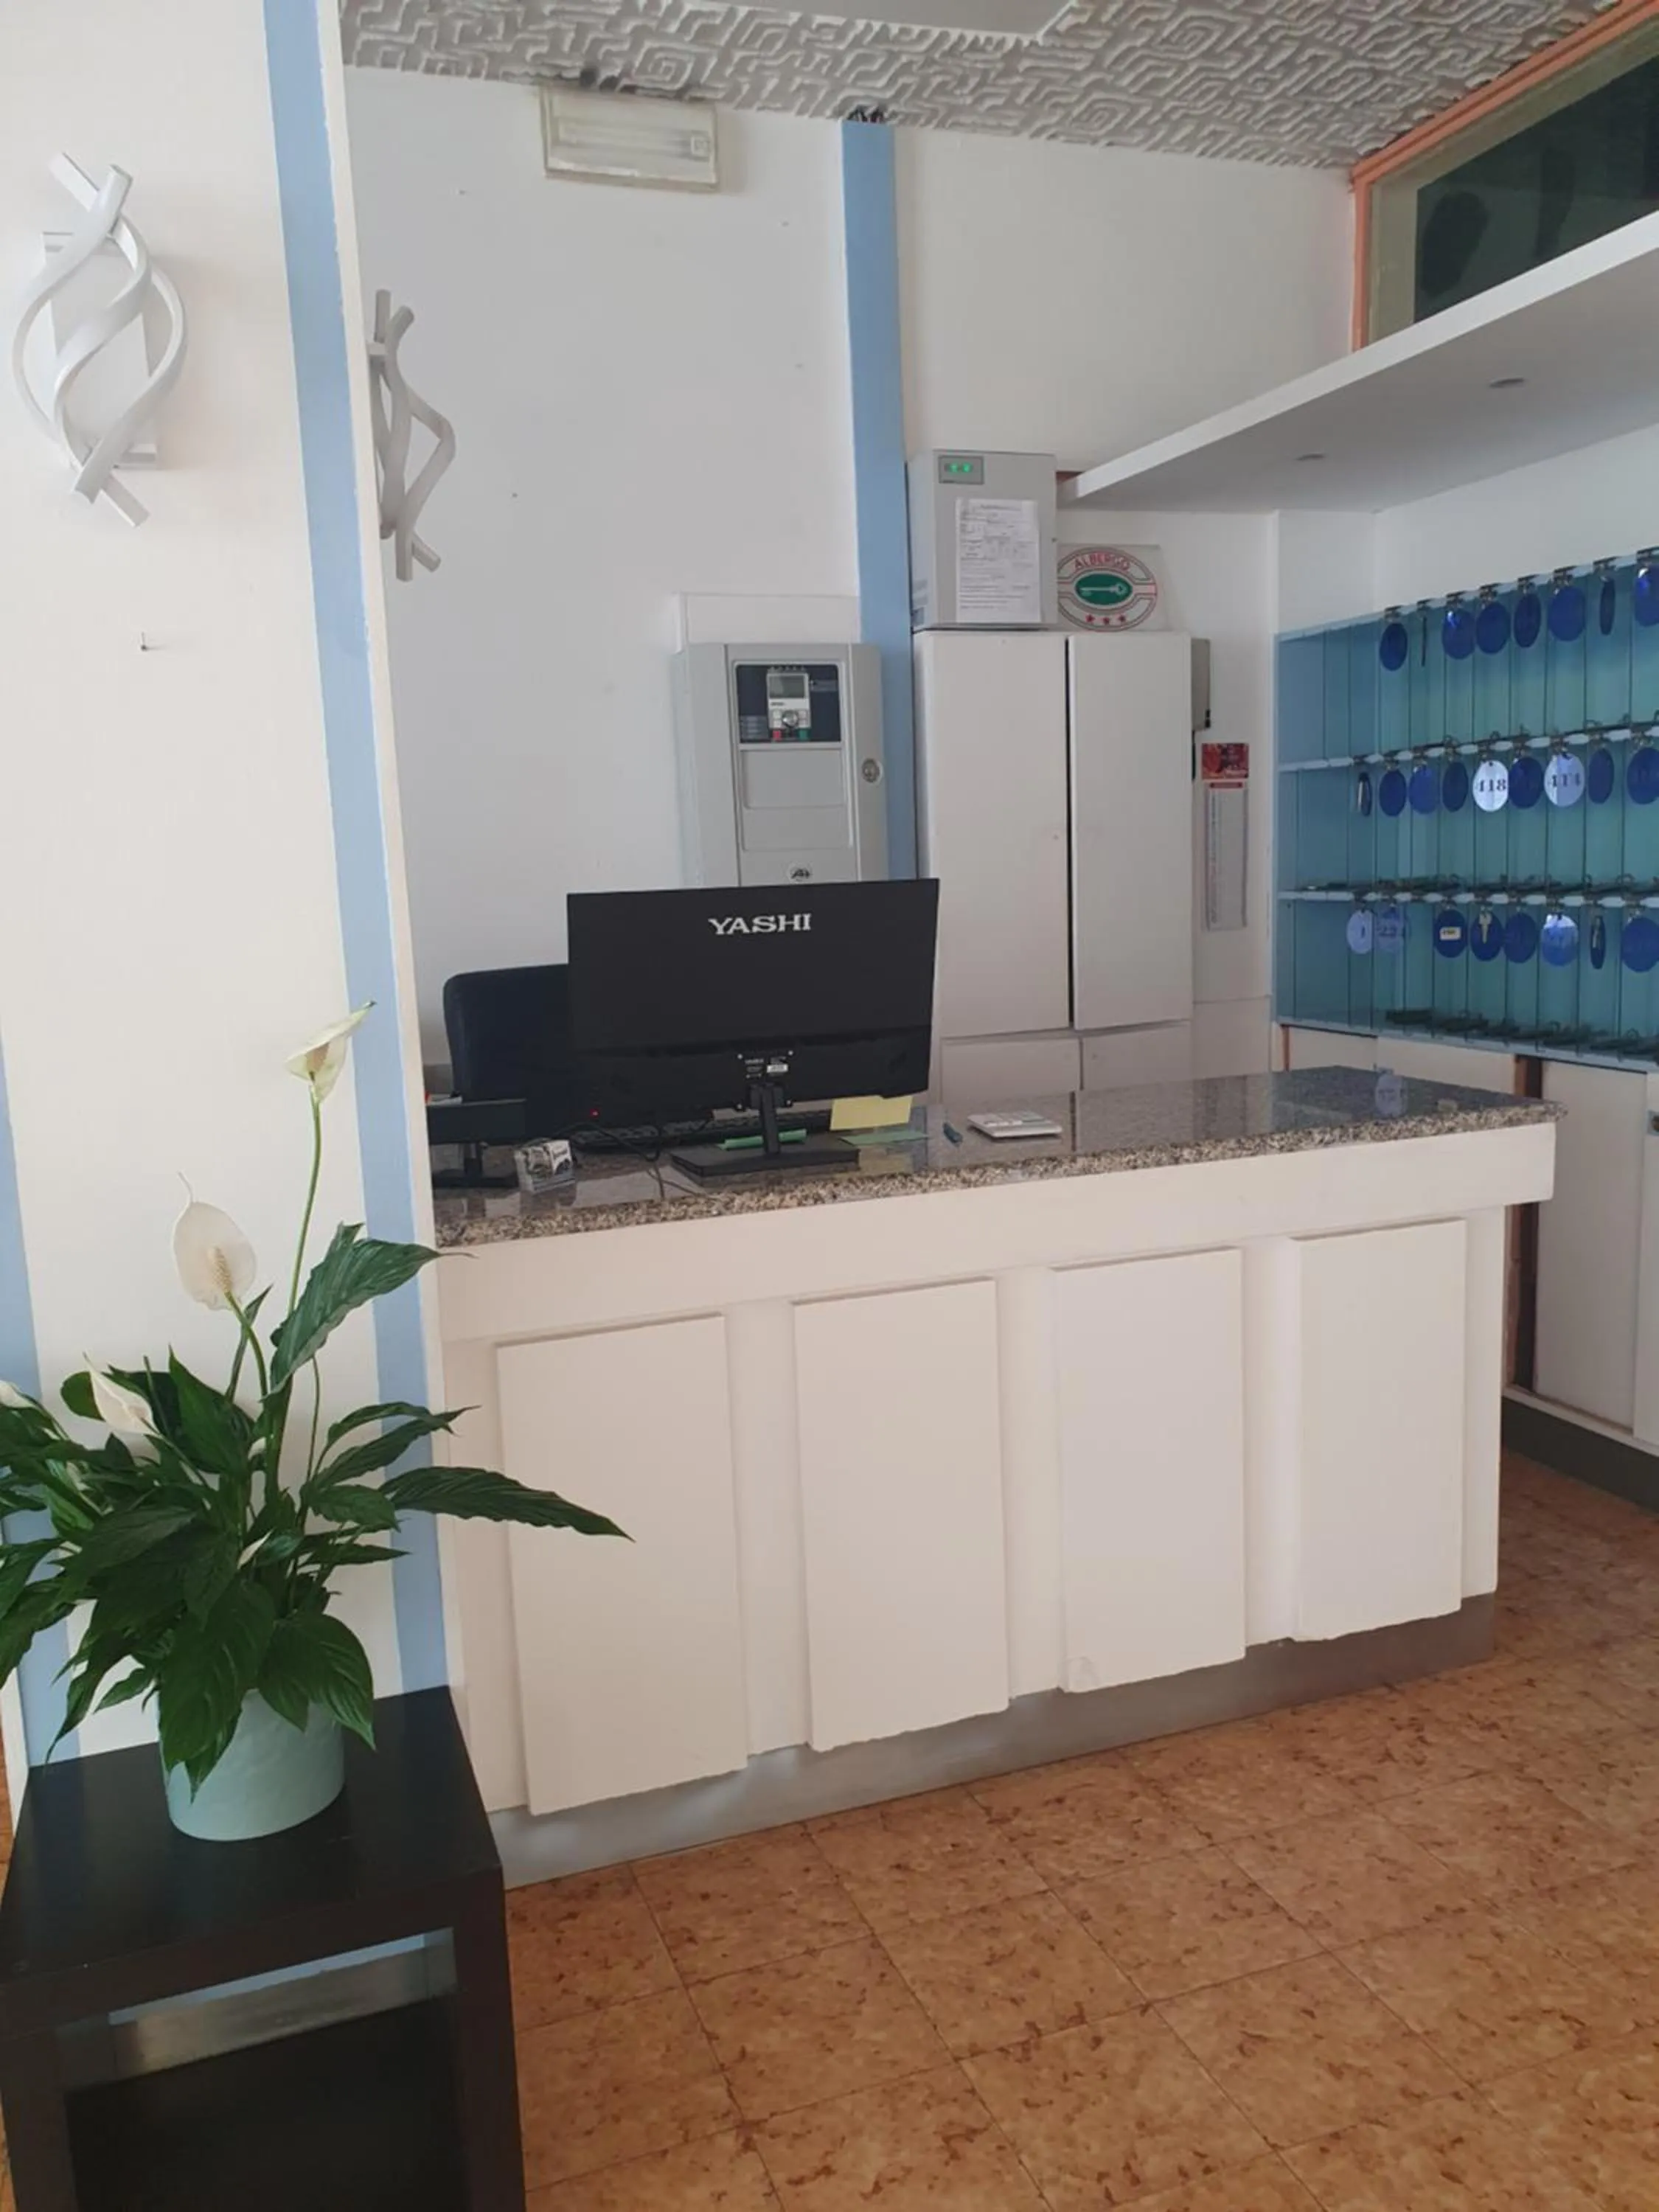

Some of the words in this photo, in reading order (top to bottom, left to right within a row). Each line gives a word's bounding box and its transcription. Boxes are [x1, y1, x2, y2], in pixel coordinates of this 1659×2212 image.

[1074, 552, 1130, 571] ALBERGO
[1478, 779, 1506, 793] 118
[707, 913, 812, 935] YASHI
